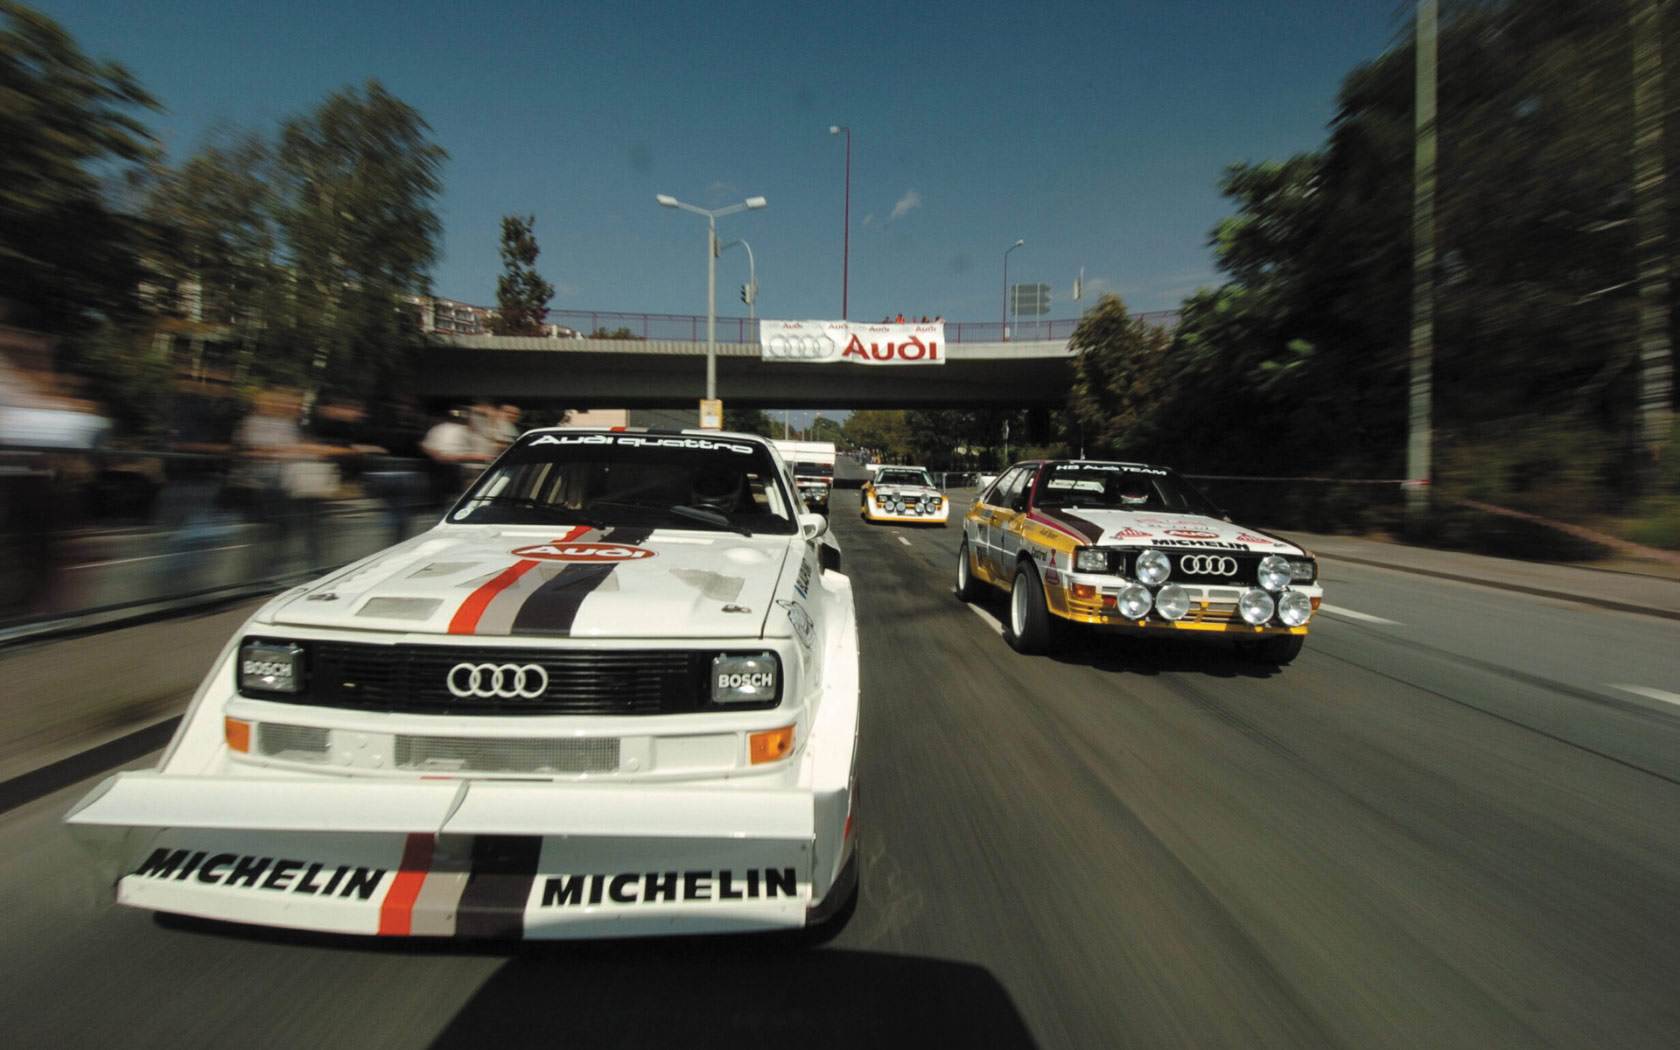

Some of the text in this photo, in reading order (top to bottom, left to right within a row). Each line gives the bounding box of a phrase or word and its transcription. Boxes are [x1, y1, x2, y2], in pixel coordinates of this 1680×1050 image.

[842, 333, 937, 361] Audi
[529, 434, 754, 454] Audi quattro
[516, 545, 647, 558] Audi
[1151, 538, 1250, 551] MICHELIN
[243, 660, 292, 677] BOSCH
[718, 672, 773, 688] BOSCH
[134, 848, 387, 900] MICHELIN
[541, 867, 798, 908] MICHELIN
